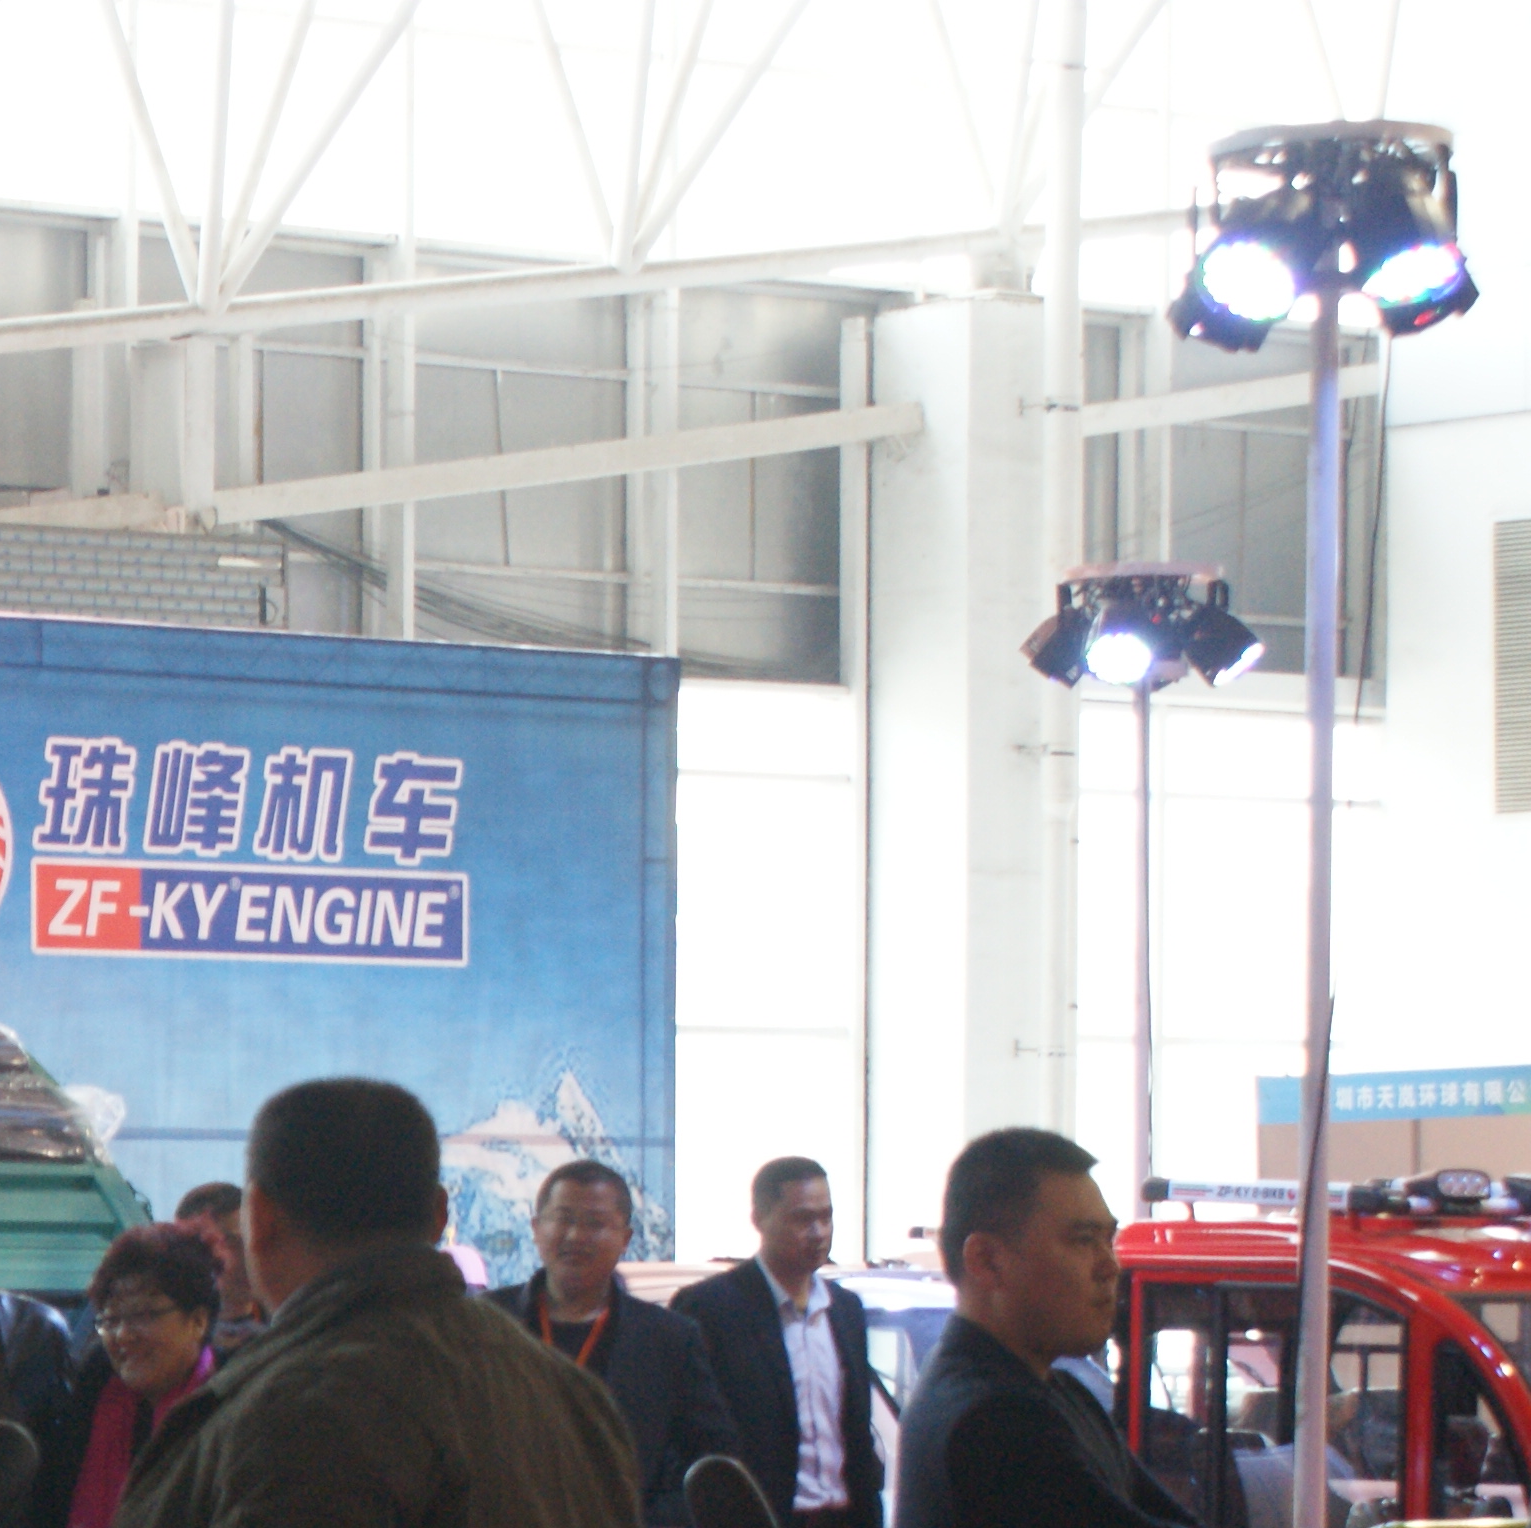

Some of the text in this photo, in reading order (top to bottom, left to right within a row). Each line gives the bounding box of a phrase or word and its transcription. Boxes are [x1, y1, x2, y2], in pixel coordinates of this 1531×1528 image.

[37, 740, 461, 862] 珠峰机车
[47, 877, 448, 950] ZF-KY ENGINE
